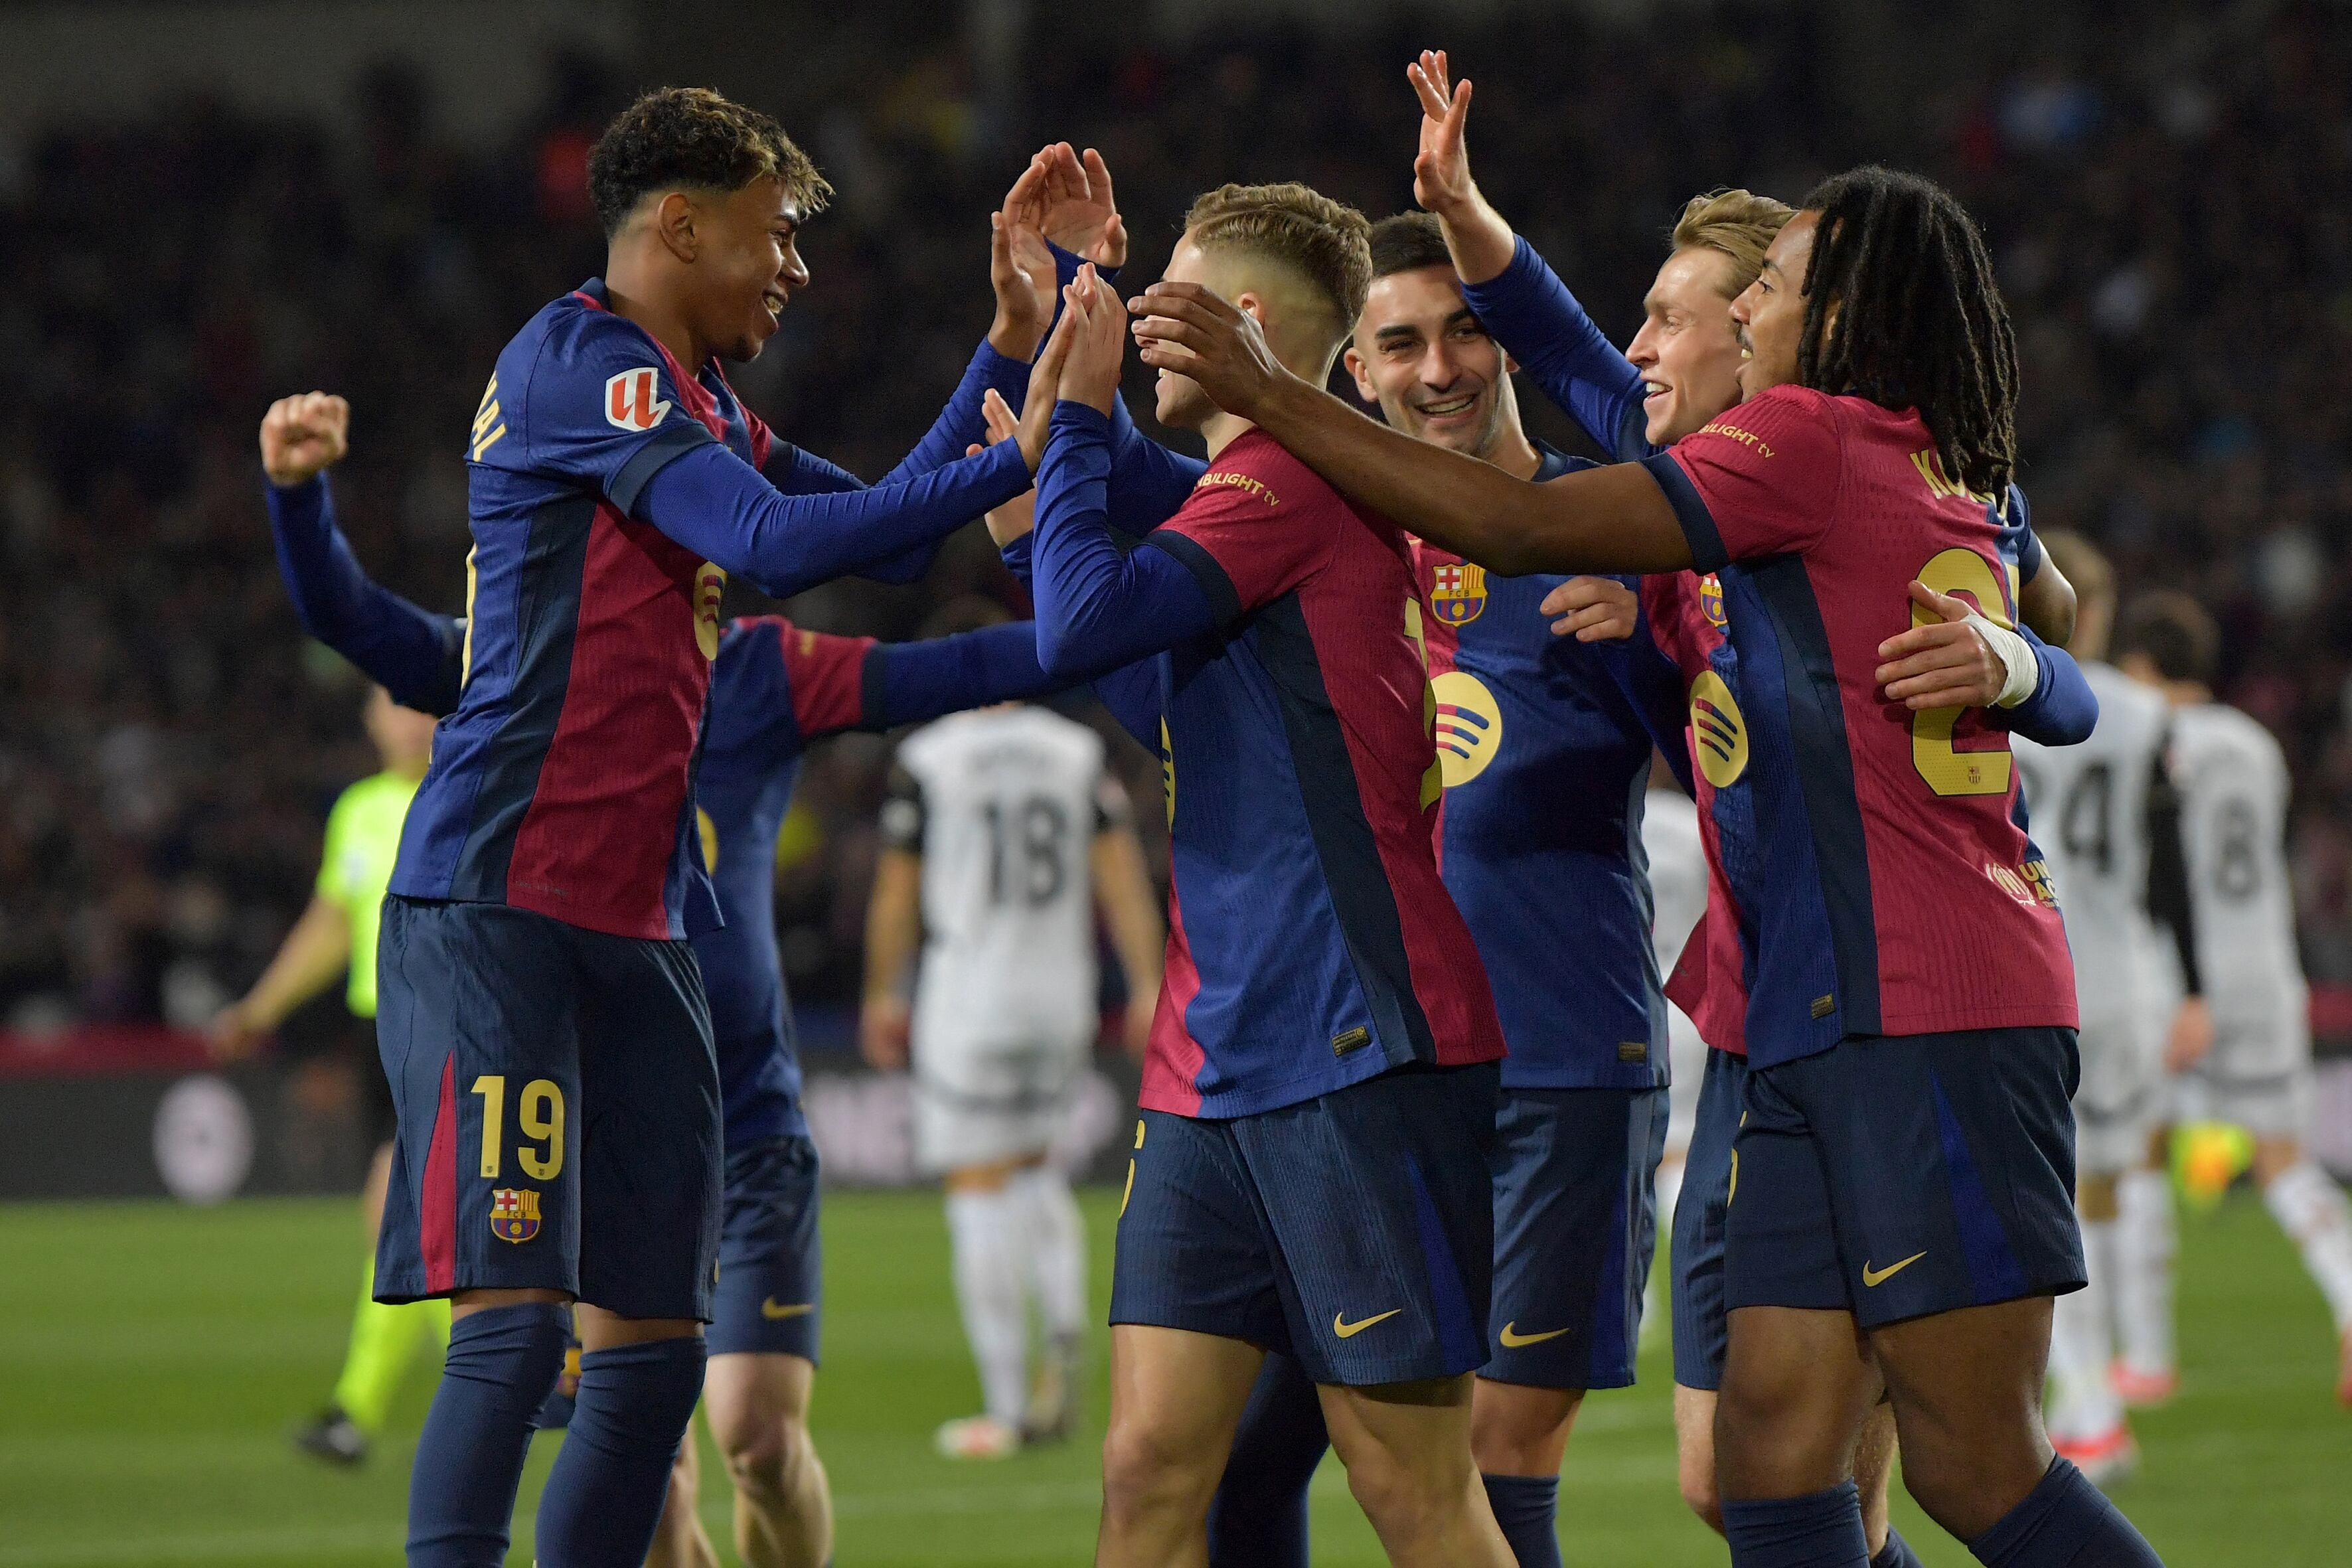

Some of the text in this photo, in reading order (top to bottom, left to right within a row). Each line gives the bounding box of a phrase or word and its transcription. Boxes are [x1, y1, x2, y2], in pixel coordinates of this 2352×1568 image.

[982, 795, 1066, 908] 18
[2213, 800, 2263, 900] 8
[471, 1075, 564, 1180] 19
